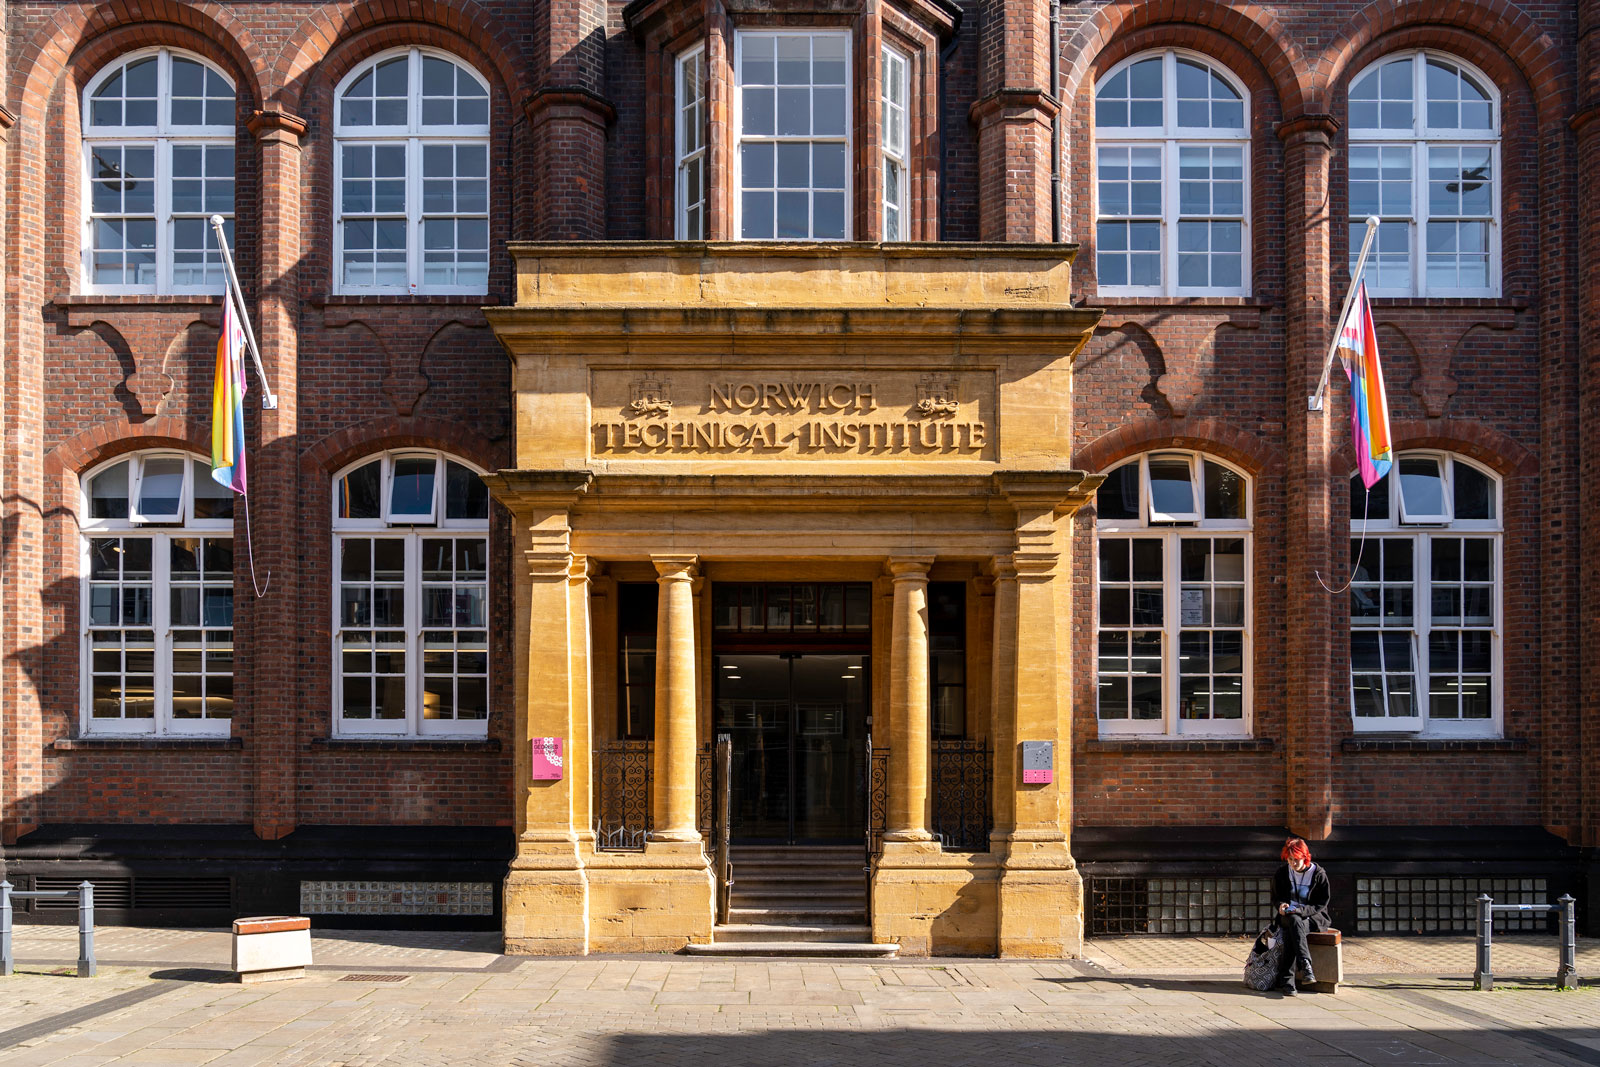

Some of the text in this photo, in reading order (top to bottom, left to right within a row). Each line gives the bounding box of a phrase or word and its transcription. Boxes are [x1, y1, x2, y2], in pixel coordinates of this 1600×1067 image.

[708, 383, 879, 410] NORWICH
[598, 422, 987, 448] TECHNICAL INSTITUTE
